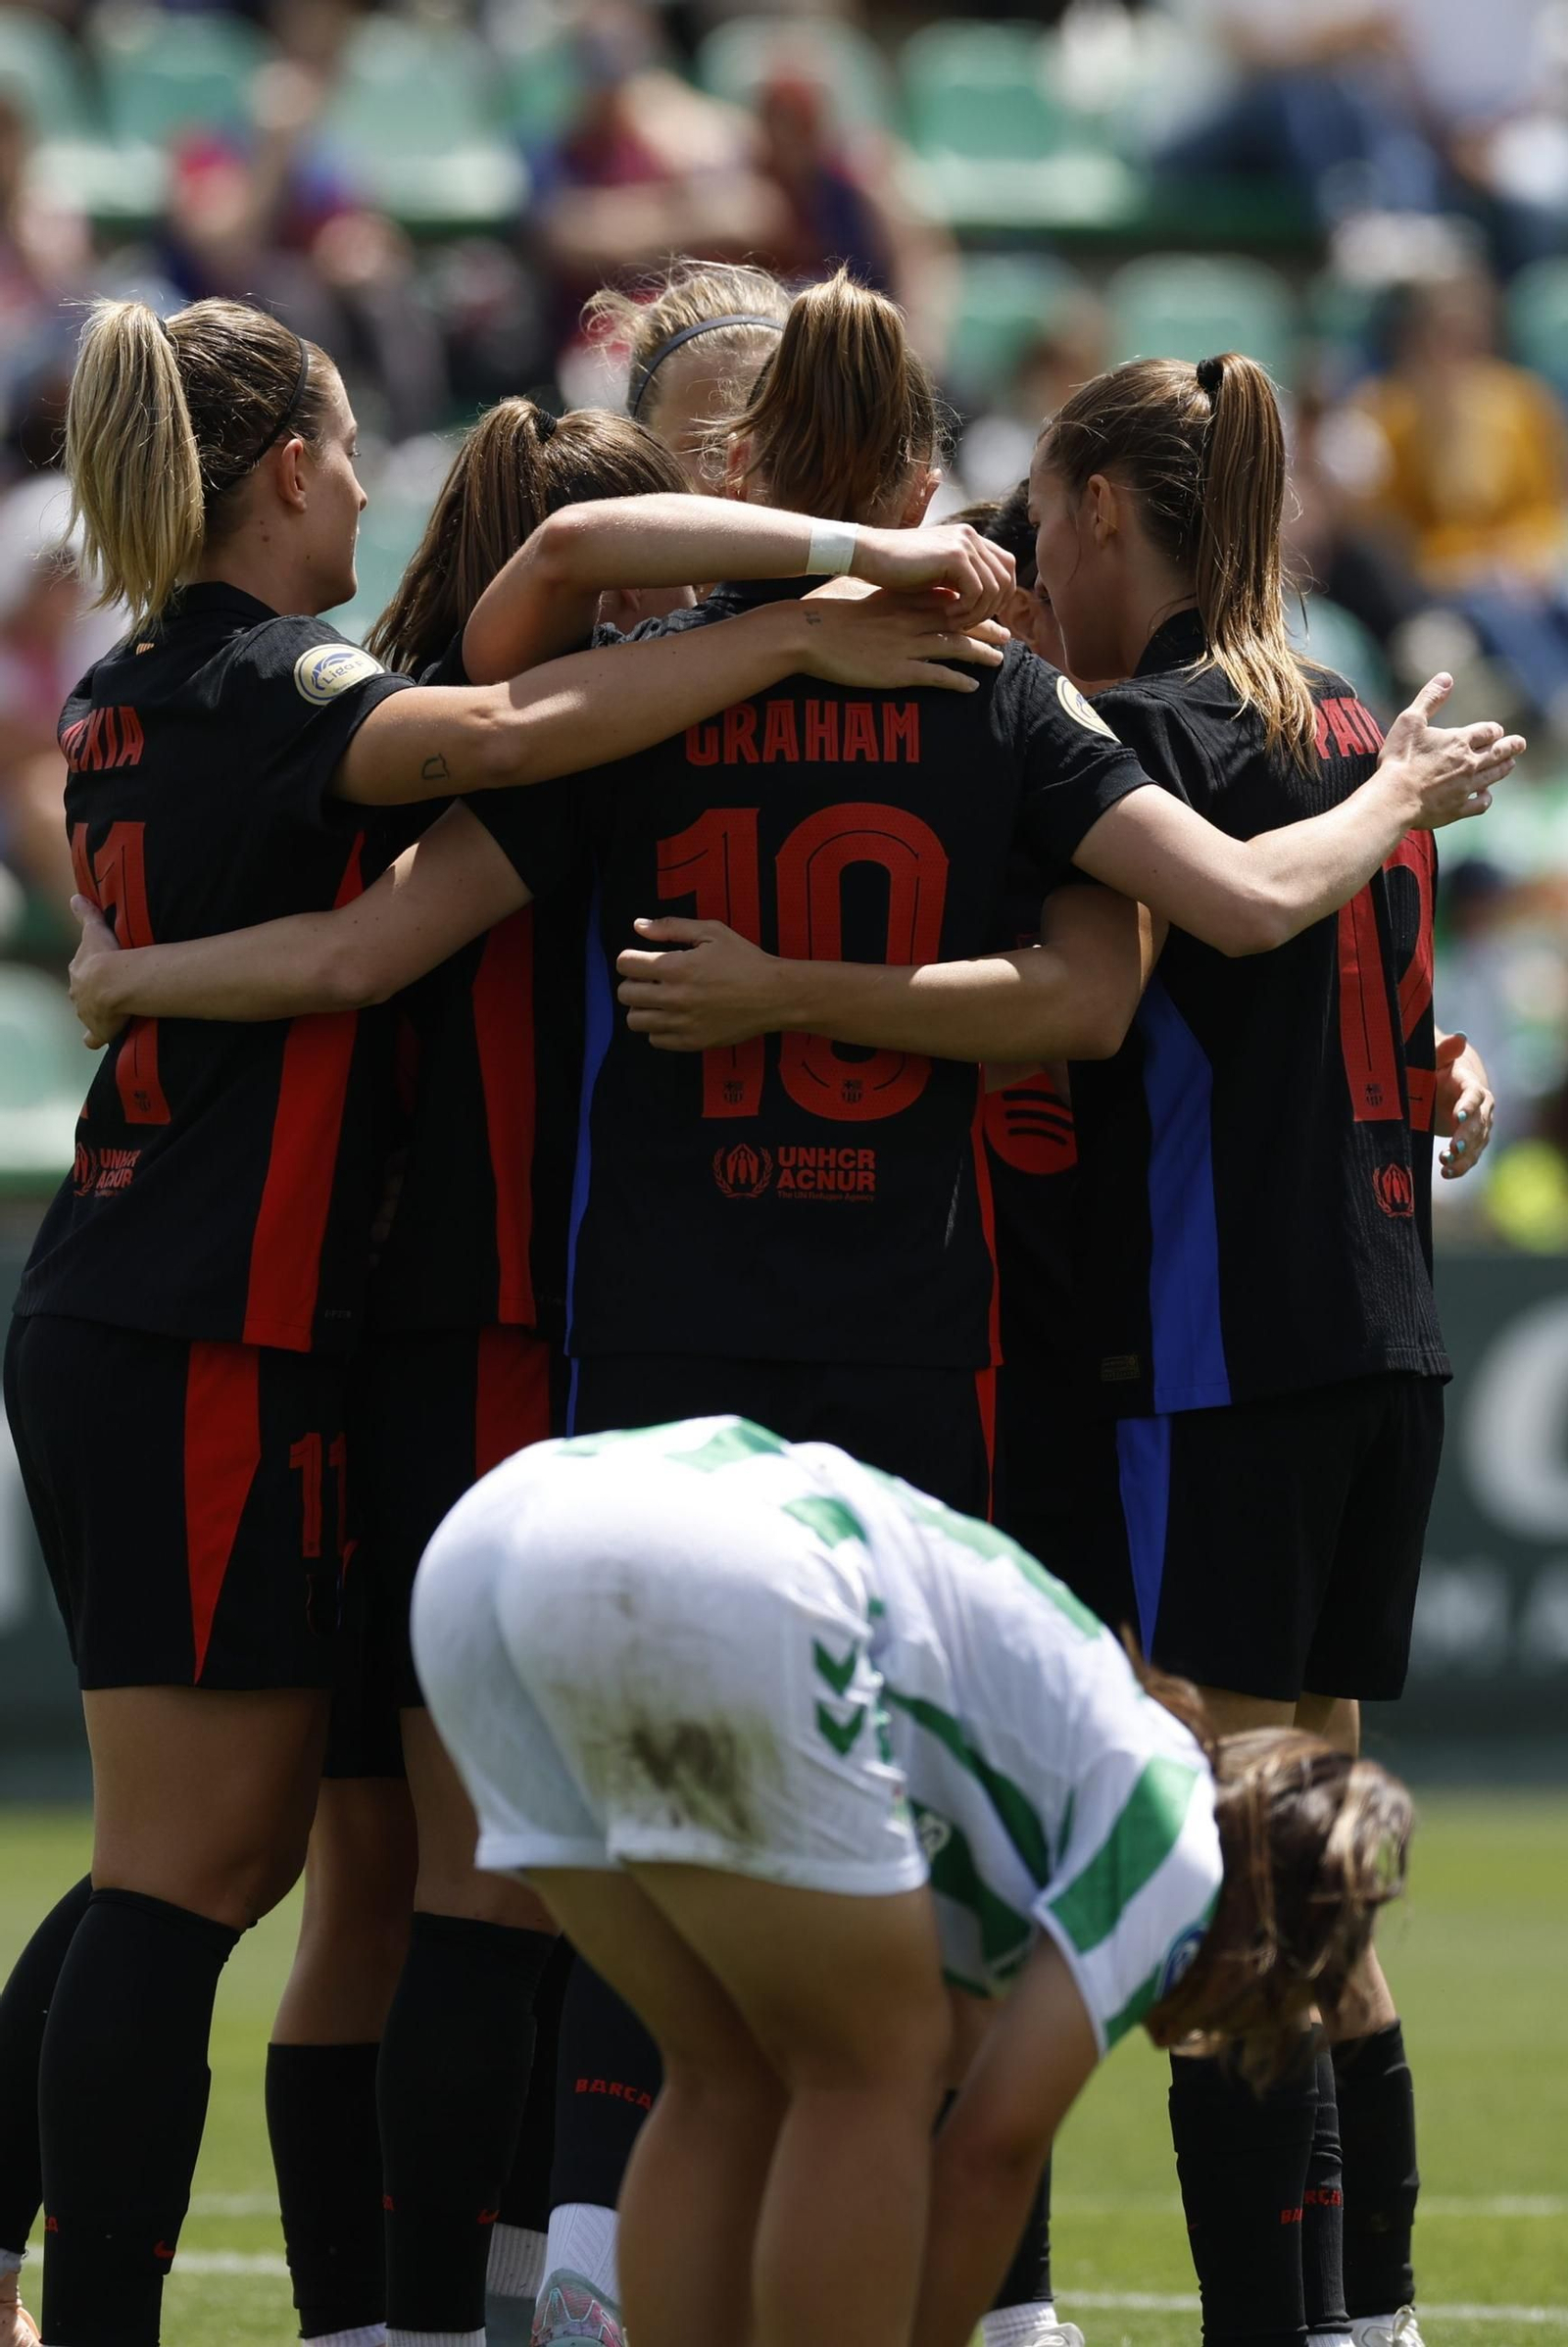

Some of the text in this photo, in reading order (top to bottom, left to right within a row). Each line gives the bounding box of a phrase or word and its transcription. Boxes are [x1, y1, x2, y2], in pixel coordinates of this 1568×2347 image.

[322, 662, 354, 684] Liga
[686, 700, 919, 766] GRAHAM
[657, 802, 950, 1121] 10
[778, 1147, 875, 1170] UNHCR
[777, 1169, 875, 1192] ACNUR
